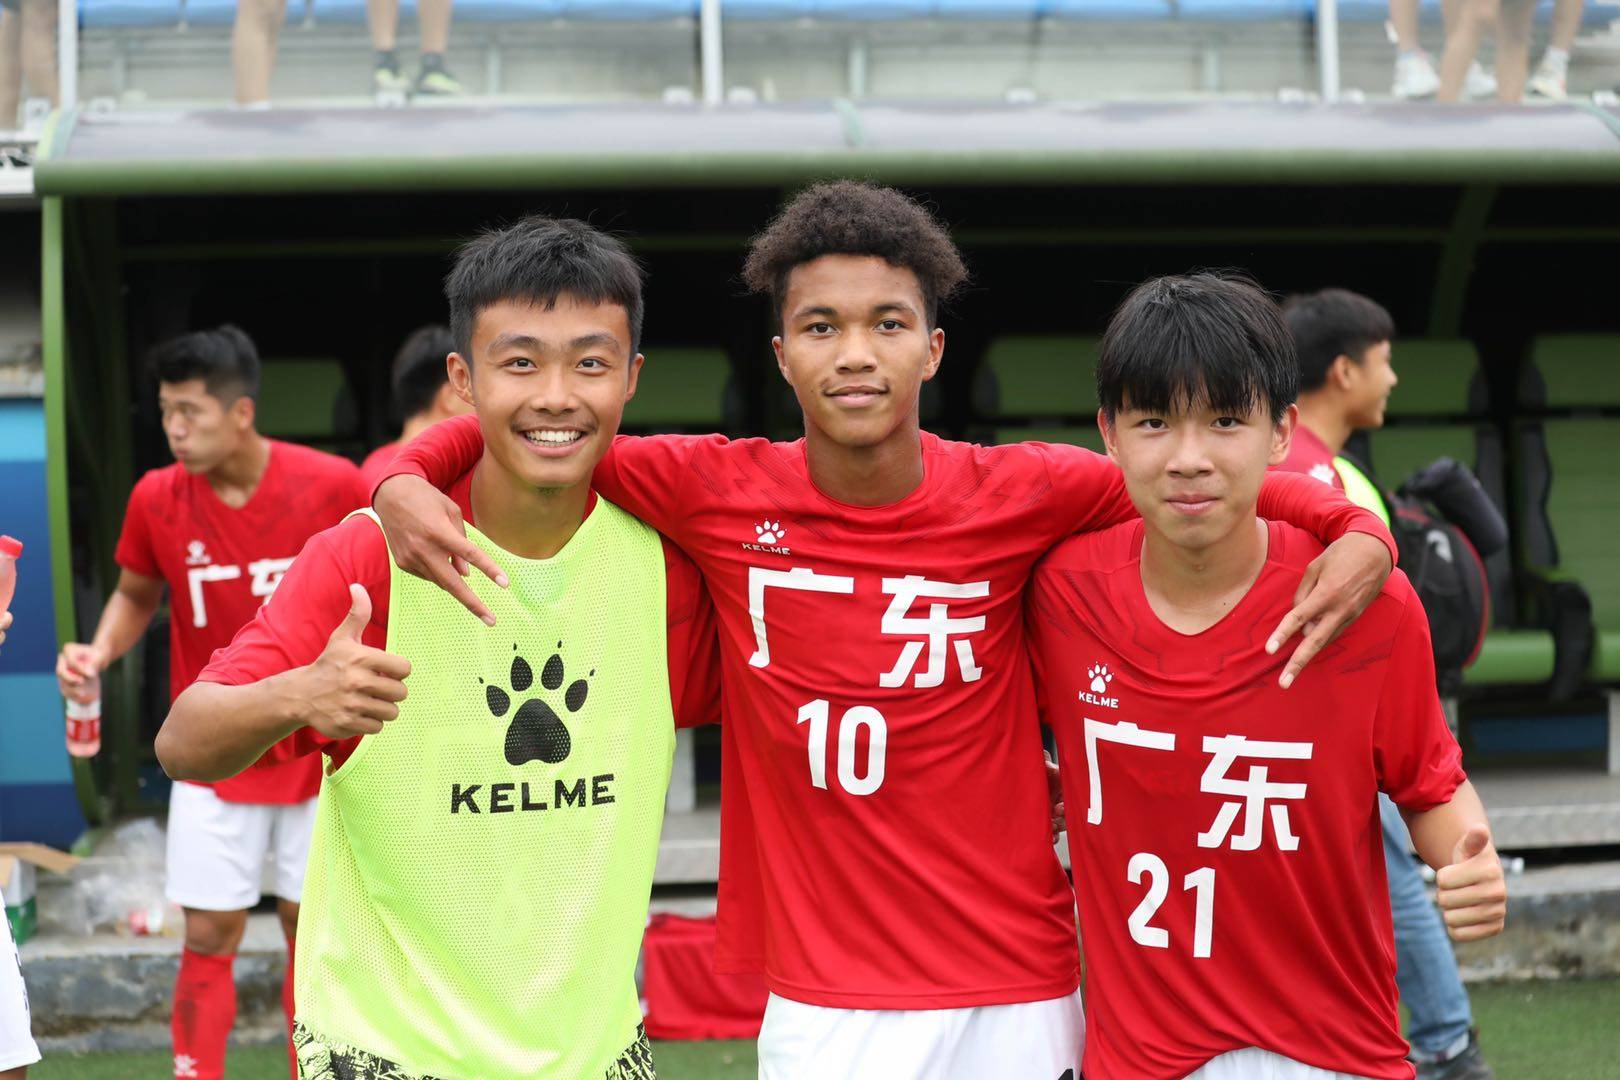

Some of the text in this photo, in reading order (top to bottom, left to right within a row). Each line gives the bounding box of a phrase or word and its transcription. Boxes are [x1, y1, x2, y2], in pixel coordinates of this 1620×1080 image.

[742, 542, 790, 555] KELME
[748, 566, 990, 688] 广东
[797, 699, 887, 796] 10
[1078, 691, 1119, 708] KELME
[451, 773, 616, 814] KELME
[1083, 717, 1313, 851] 广东
[1127, 852, 1216, 958] 21
